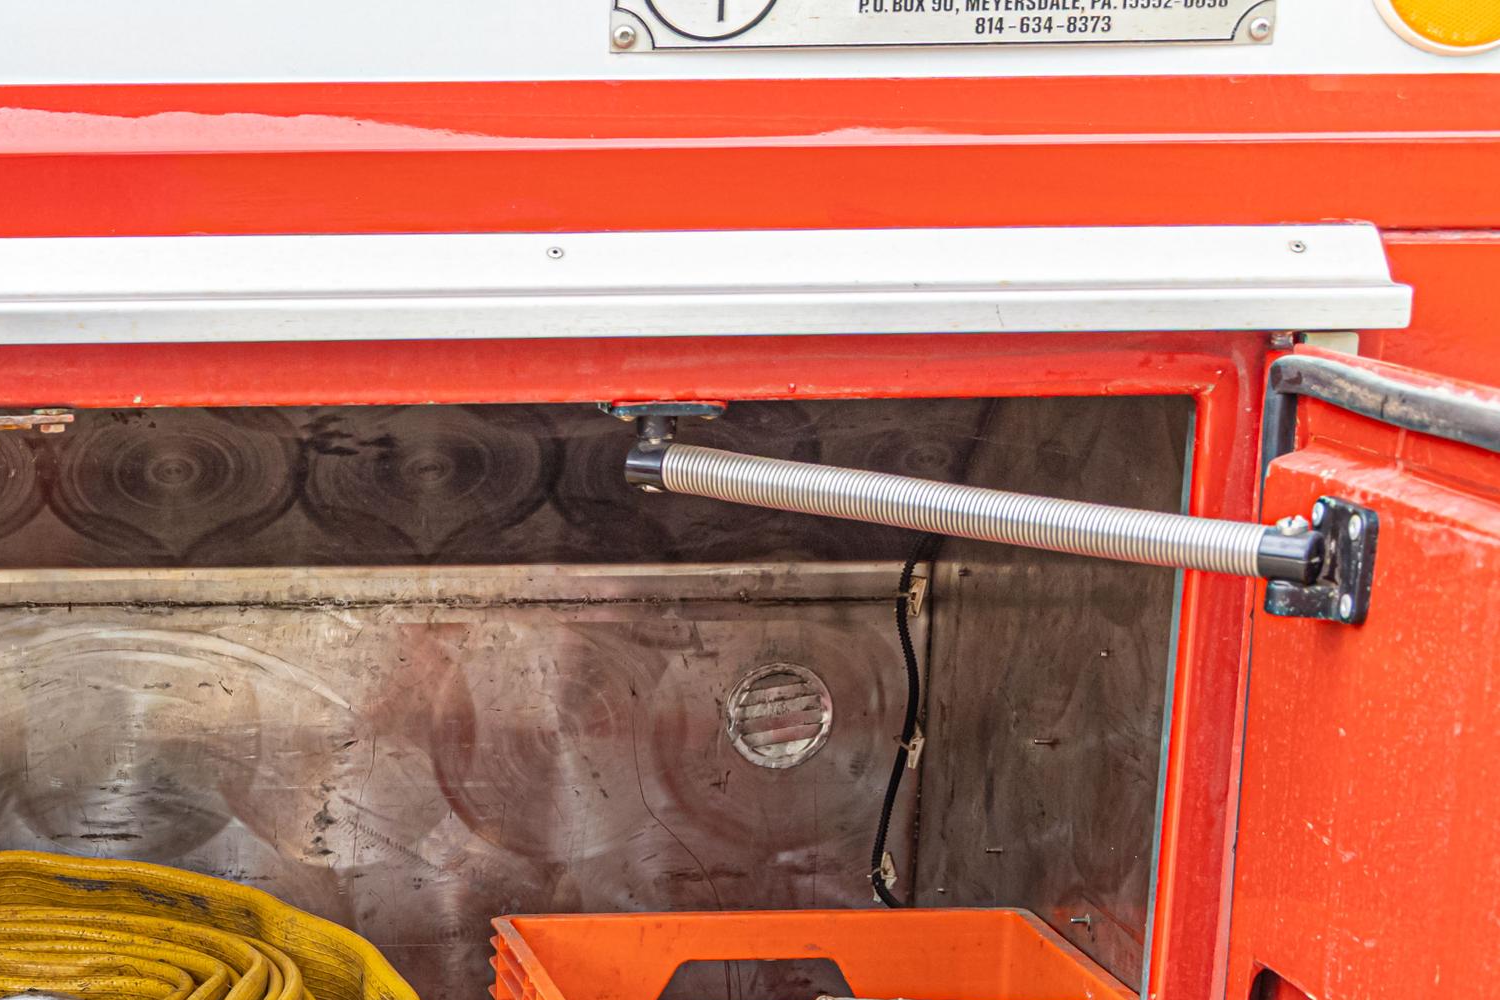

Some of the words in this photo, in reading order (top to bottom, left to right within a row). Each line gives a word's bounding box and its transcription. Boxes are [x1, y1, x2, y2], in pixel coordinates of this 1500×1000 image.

[892, 0, 926, 13] BOX
[965, 0, 1085, 13] MEYERSDALE,
[975, 15, 1112, 34] 814-634-8373
